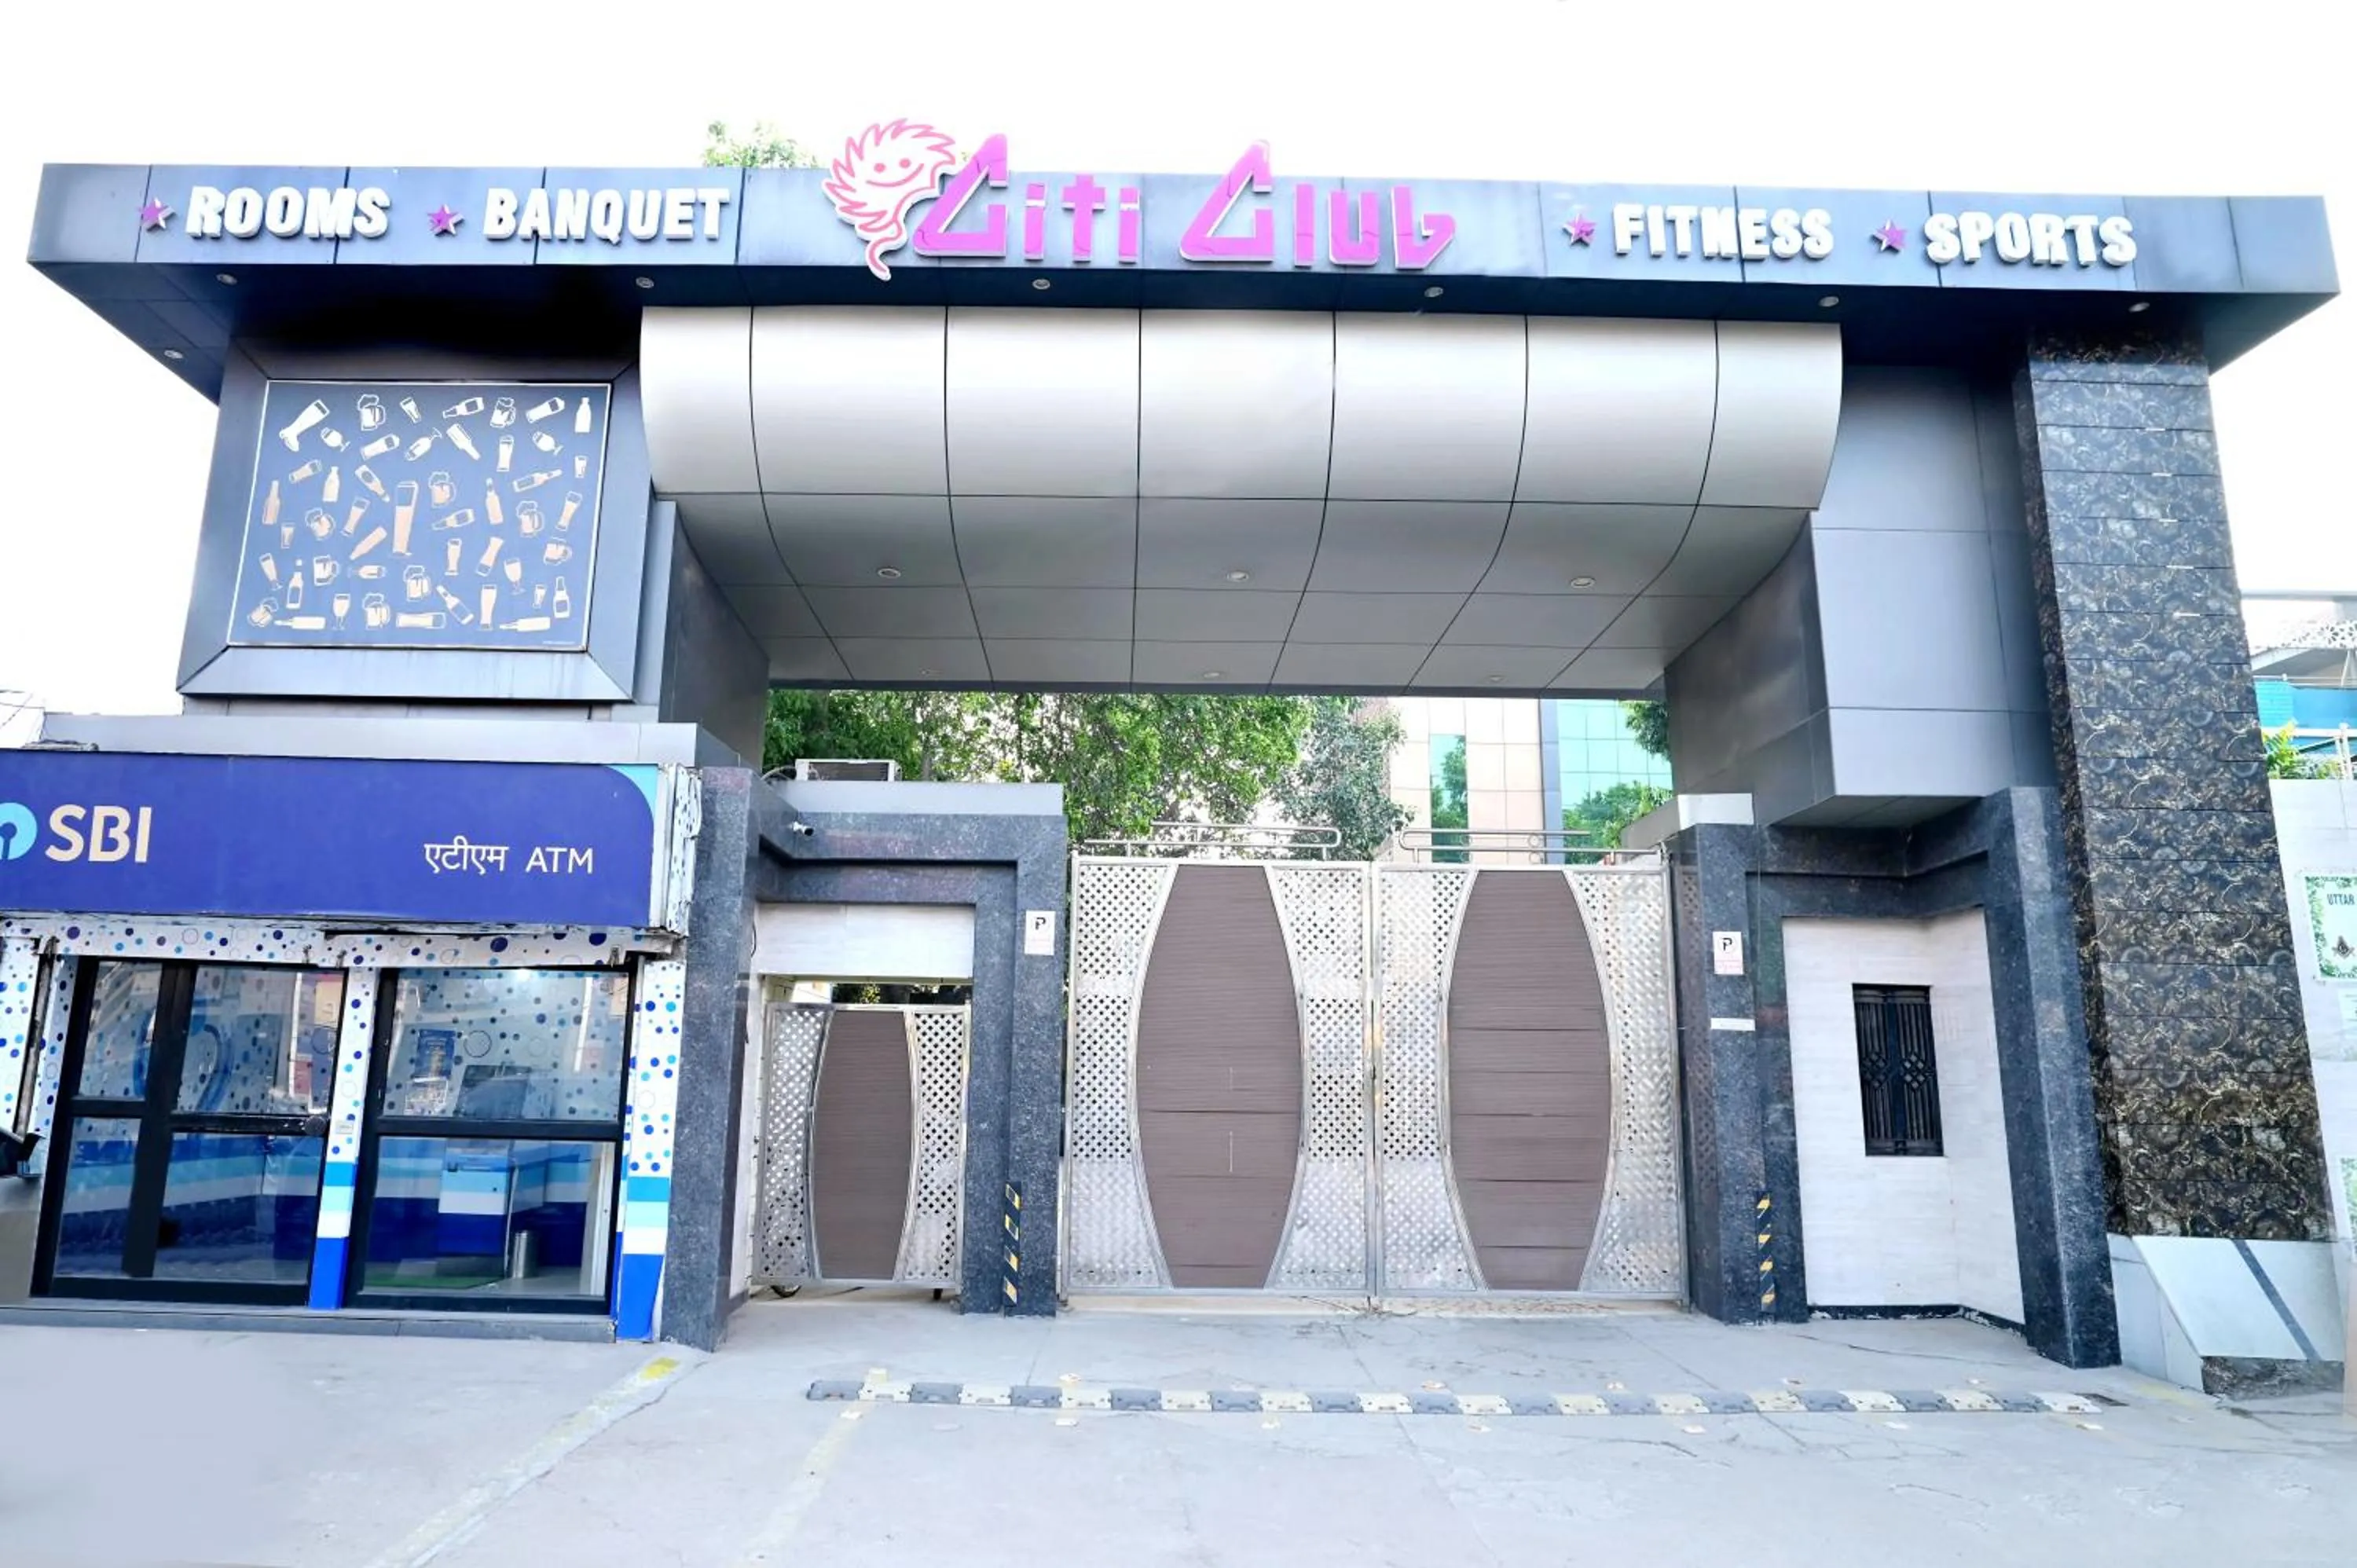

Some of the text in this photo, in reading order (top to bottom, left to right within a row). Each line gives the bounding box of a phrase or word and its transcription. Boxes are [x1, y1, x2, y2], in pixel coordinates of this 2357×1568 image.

[184, 185, 731, 245] ROOMS BANQUET
[912, 132, 1456, 269] Citi Club
[1612, 203, 2139, 267] FITNESS SPORTS
[44, 803, 152, 864] SBI
[423, 834, 595, 876] एटीएम ATM
